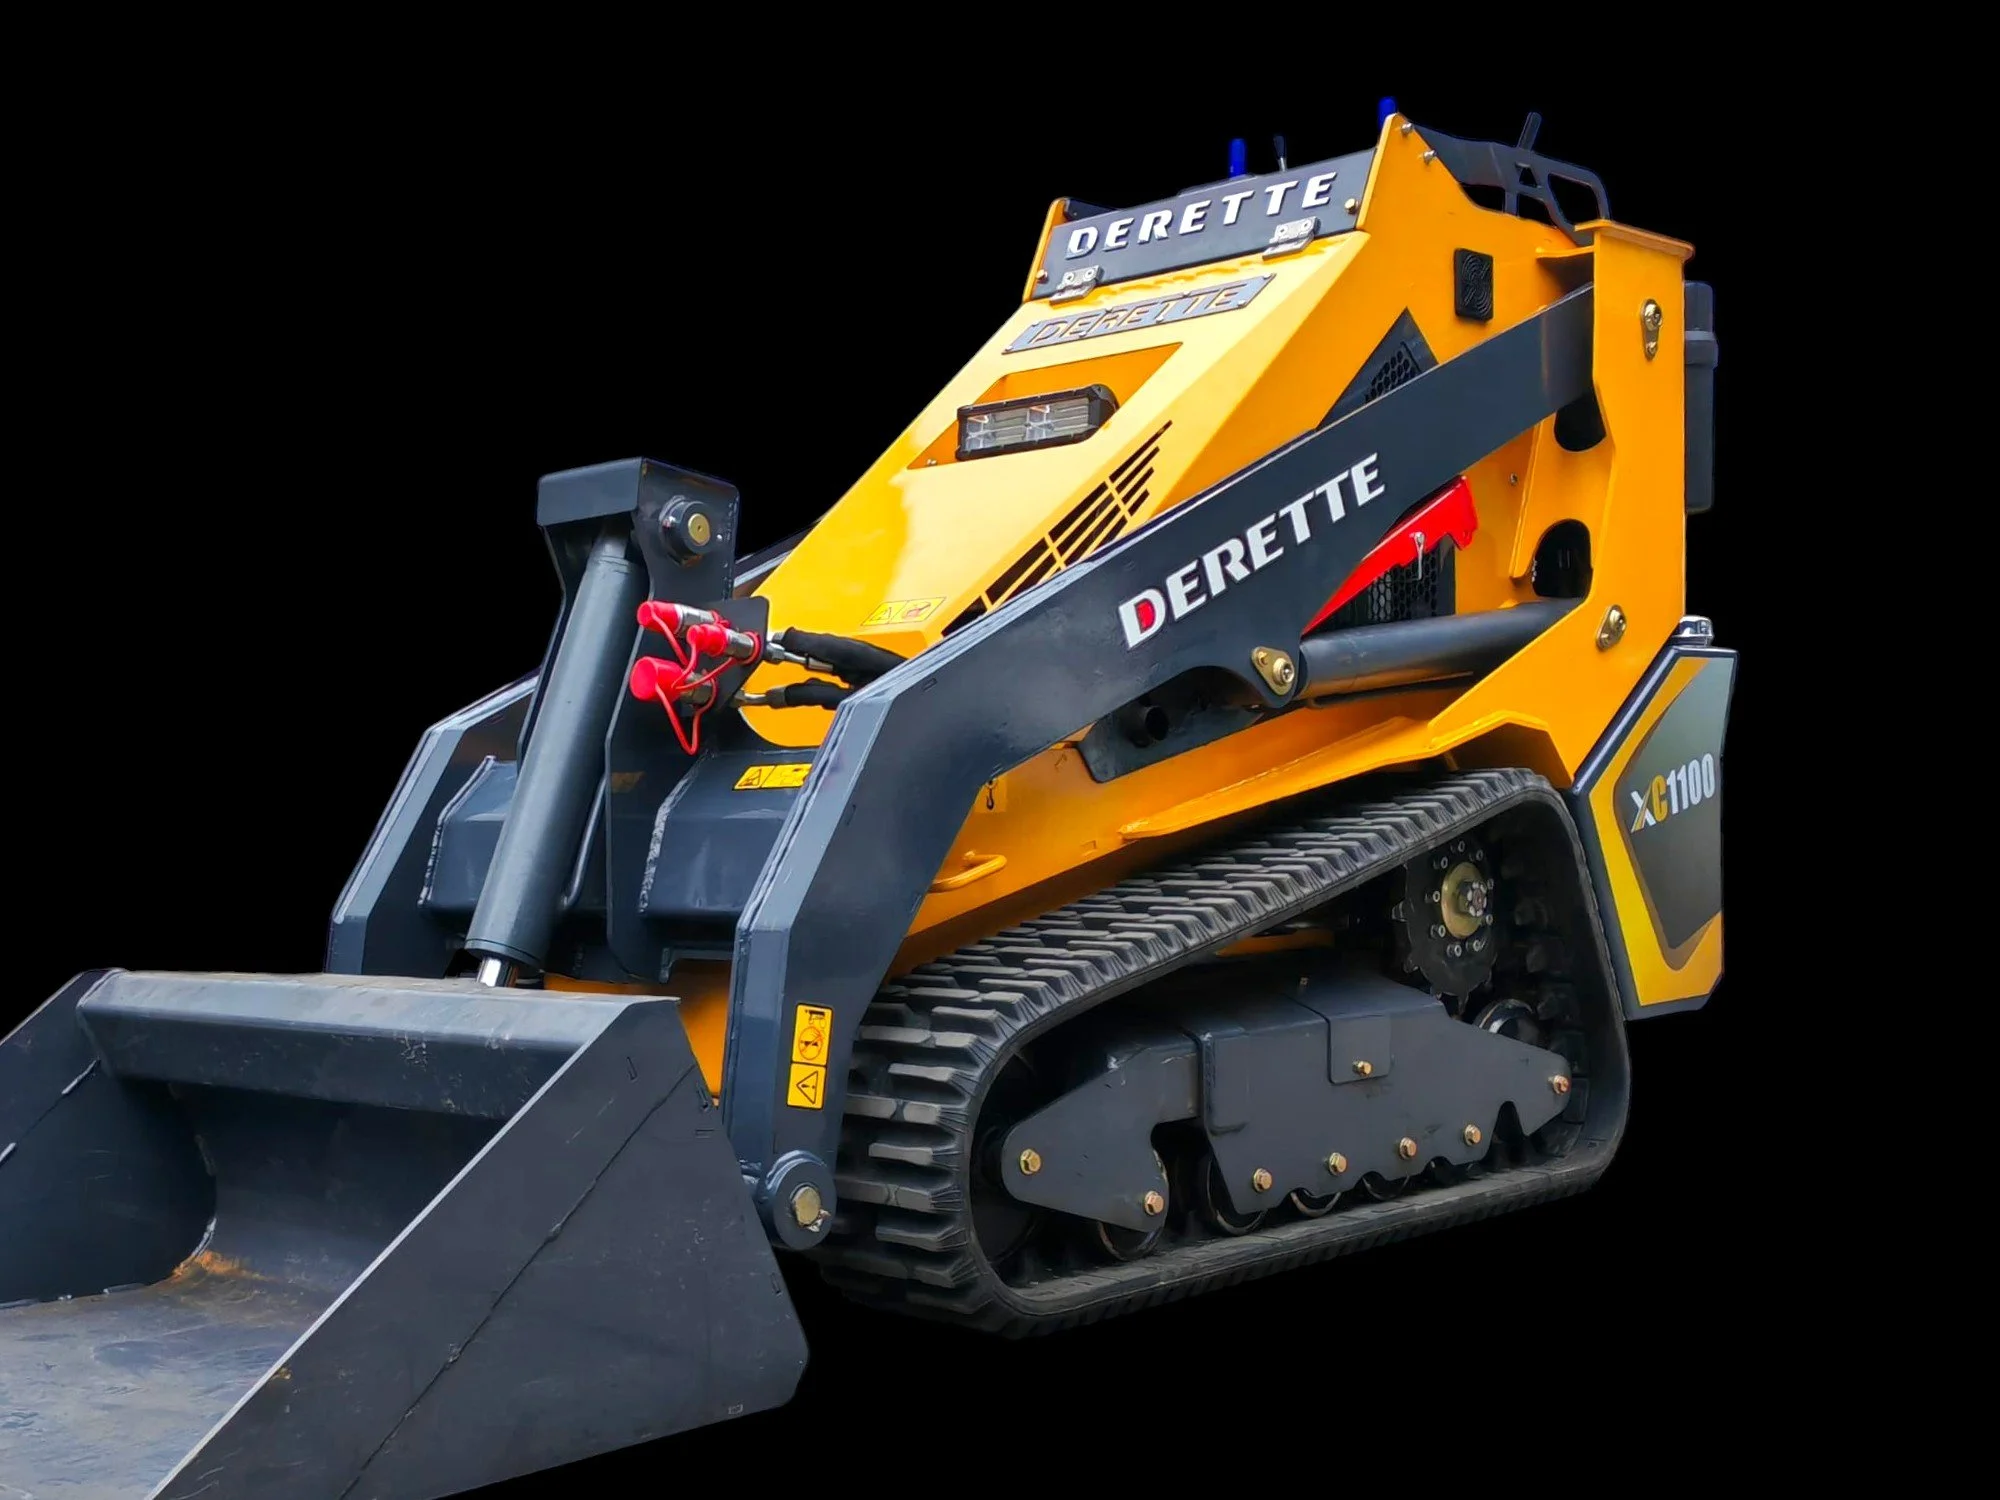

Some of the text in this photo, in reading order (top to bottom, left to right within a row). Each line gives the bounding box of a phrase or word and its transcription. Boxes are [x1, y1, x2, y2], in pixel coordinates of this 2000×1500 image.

[1066, 171, 1337, 260] DERETTE
[1029, 283, 1248, 344] DERETTE
[1118, 452, 1386, 649] DERETTE
[1630, 753, 1716, 833] XC1100
